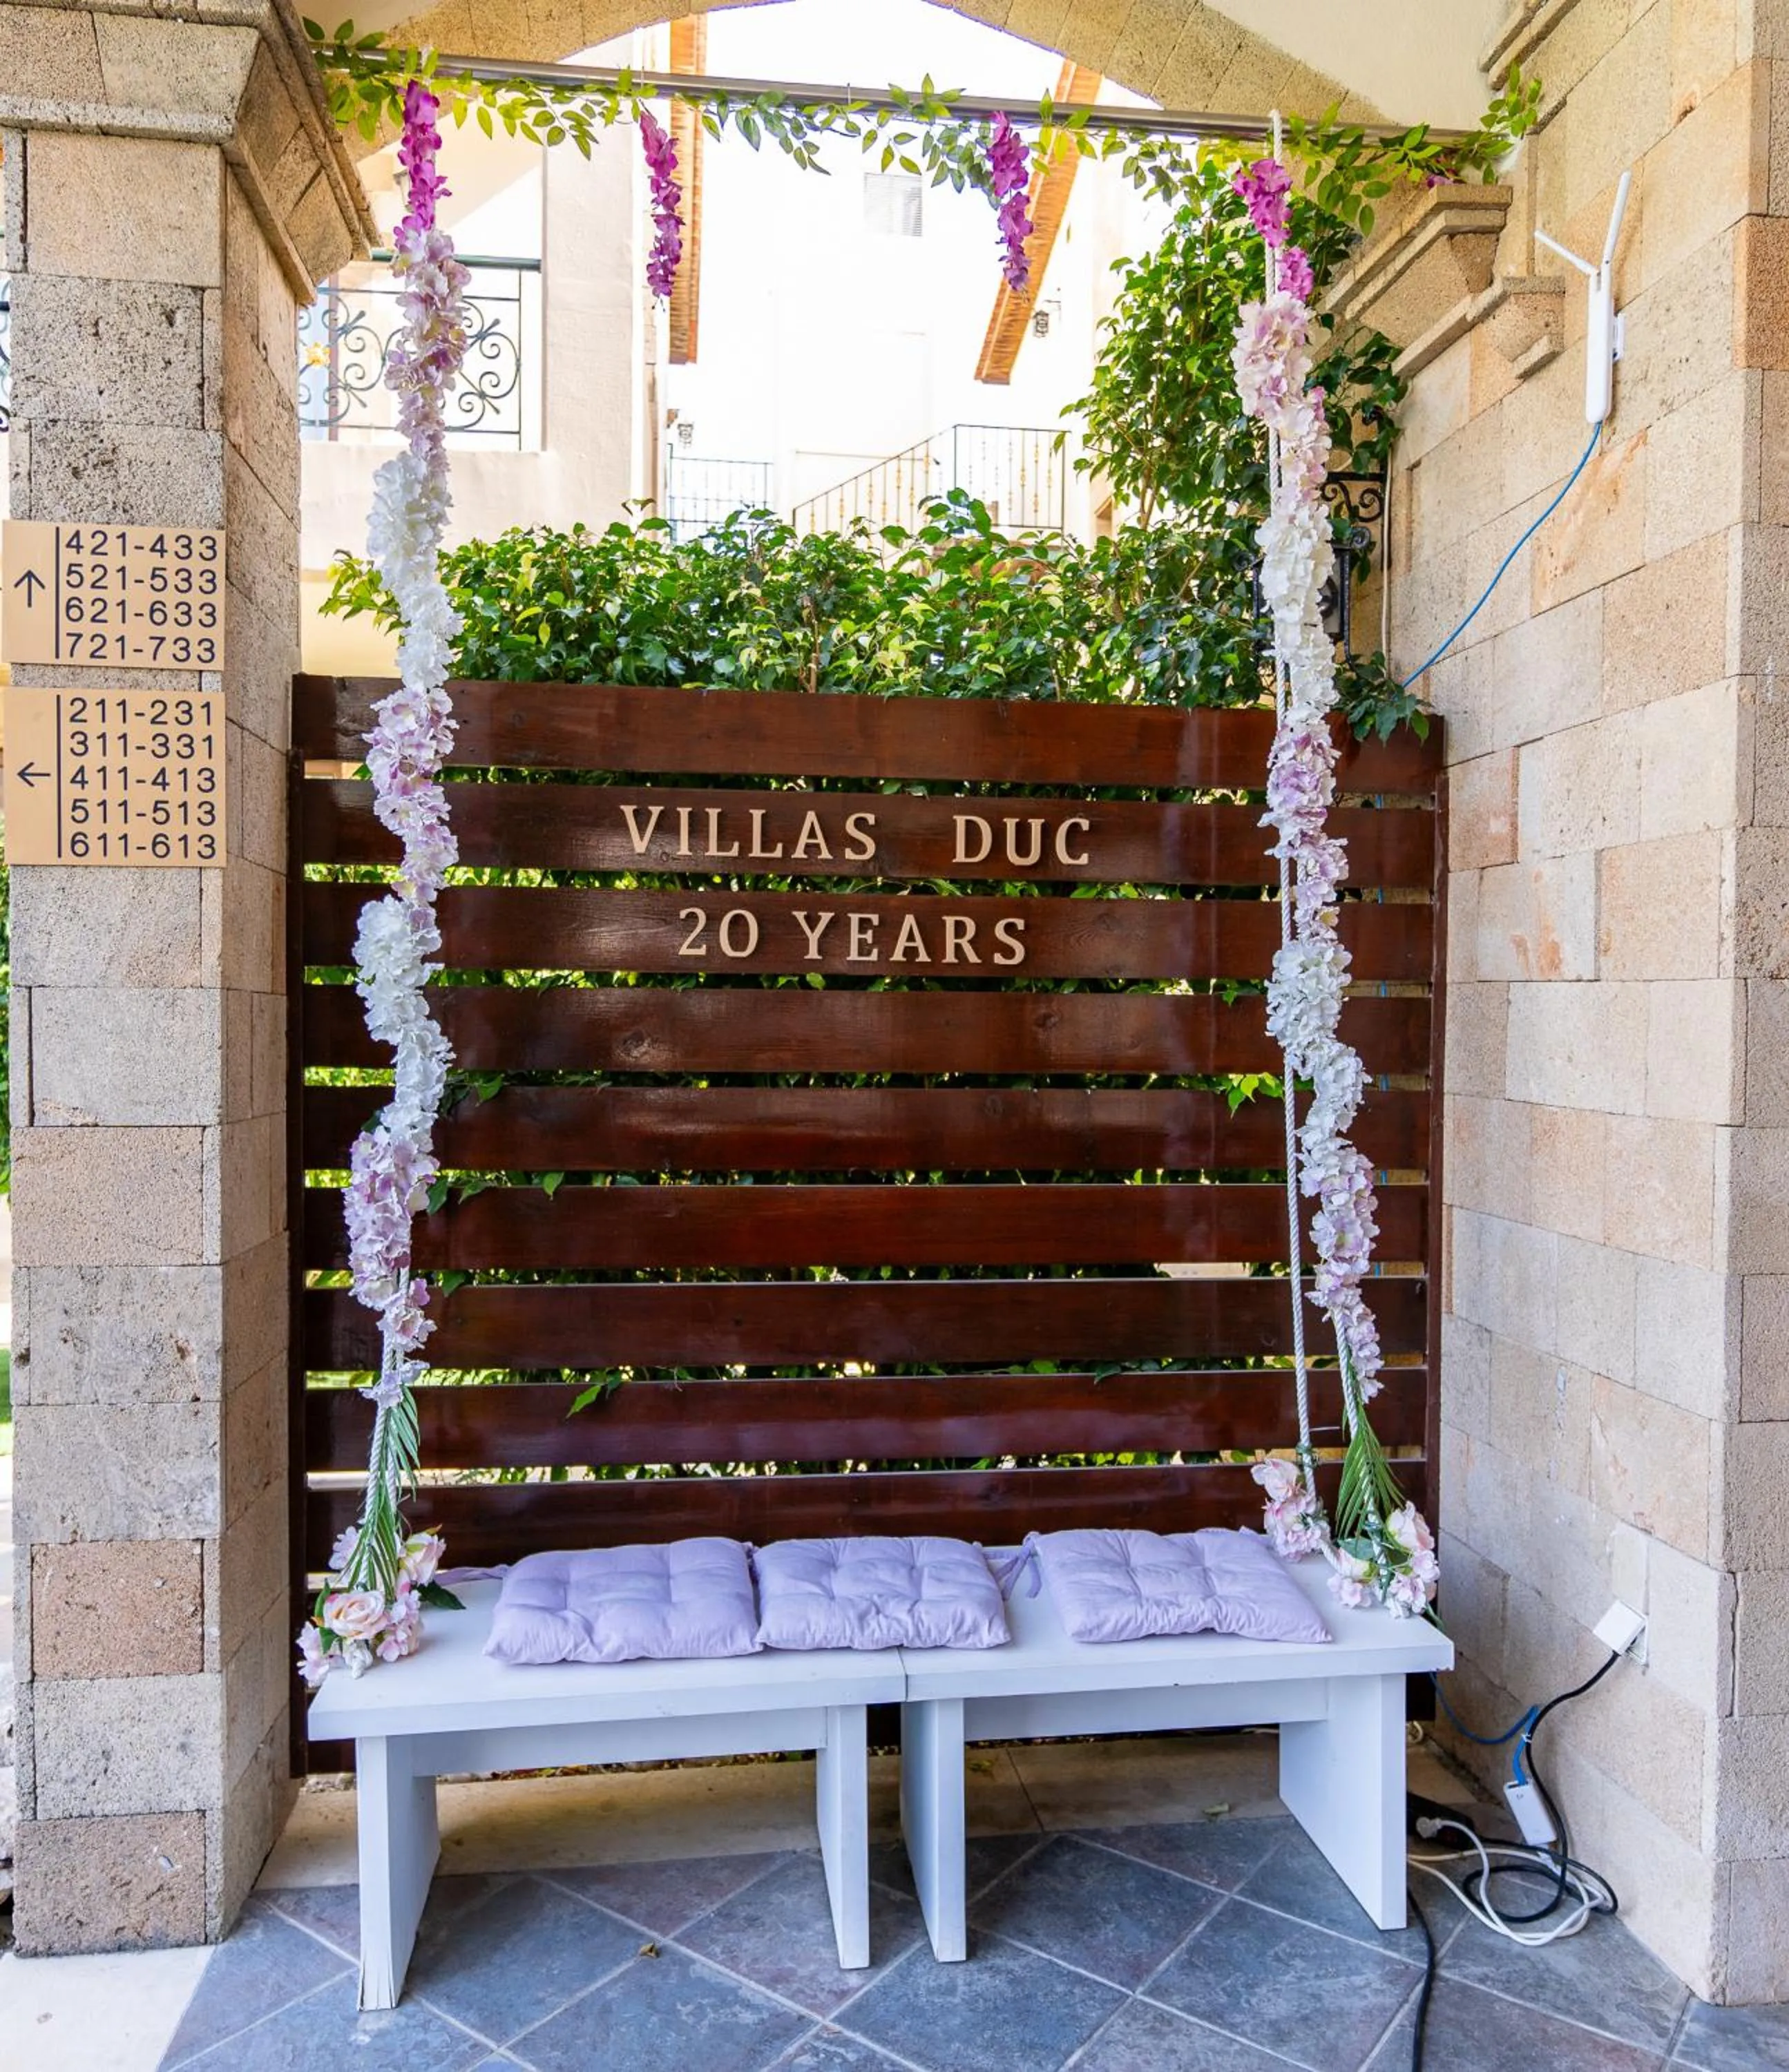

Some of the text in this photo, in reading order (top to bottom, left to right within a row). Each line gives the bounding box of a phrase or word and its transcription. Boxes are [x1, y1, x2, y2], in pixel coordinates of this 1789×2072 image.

[66, 530, 218, 561] 421-433
[65, 563, 218, 595] 521-533
[66, 596, 218, 628] 621-633
[66, 633, 216, 663] 721-733
[69, 697, 213, 726] 211-231
[69, 730, 213, 760] 311-331
[70, 765, 216, 794] 411-413
[70, 798, 216, 827] 511-513
[70, 831, 216, 860] 611-613
[620, 805, 1090, 867] VILLAS DUC
[678, 908, 1026, 966] 20 YEARS
